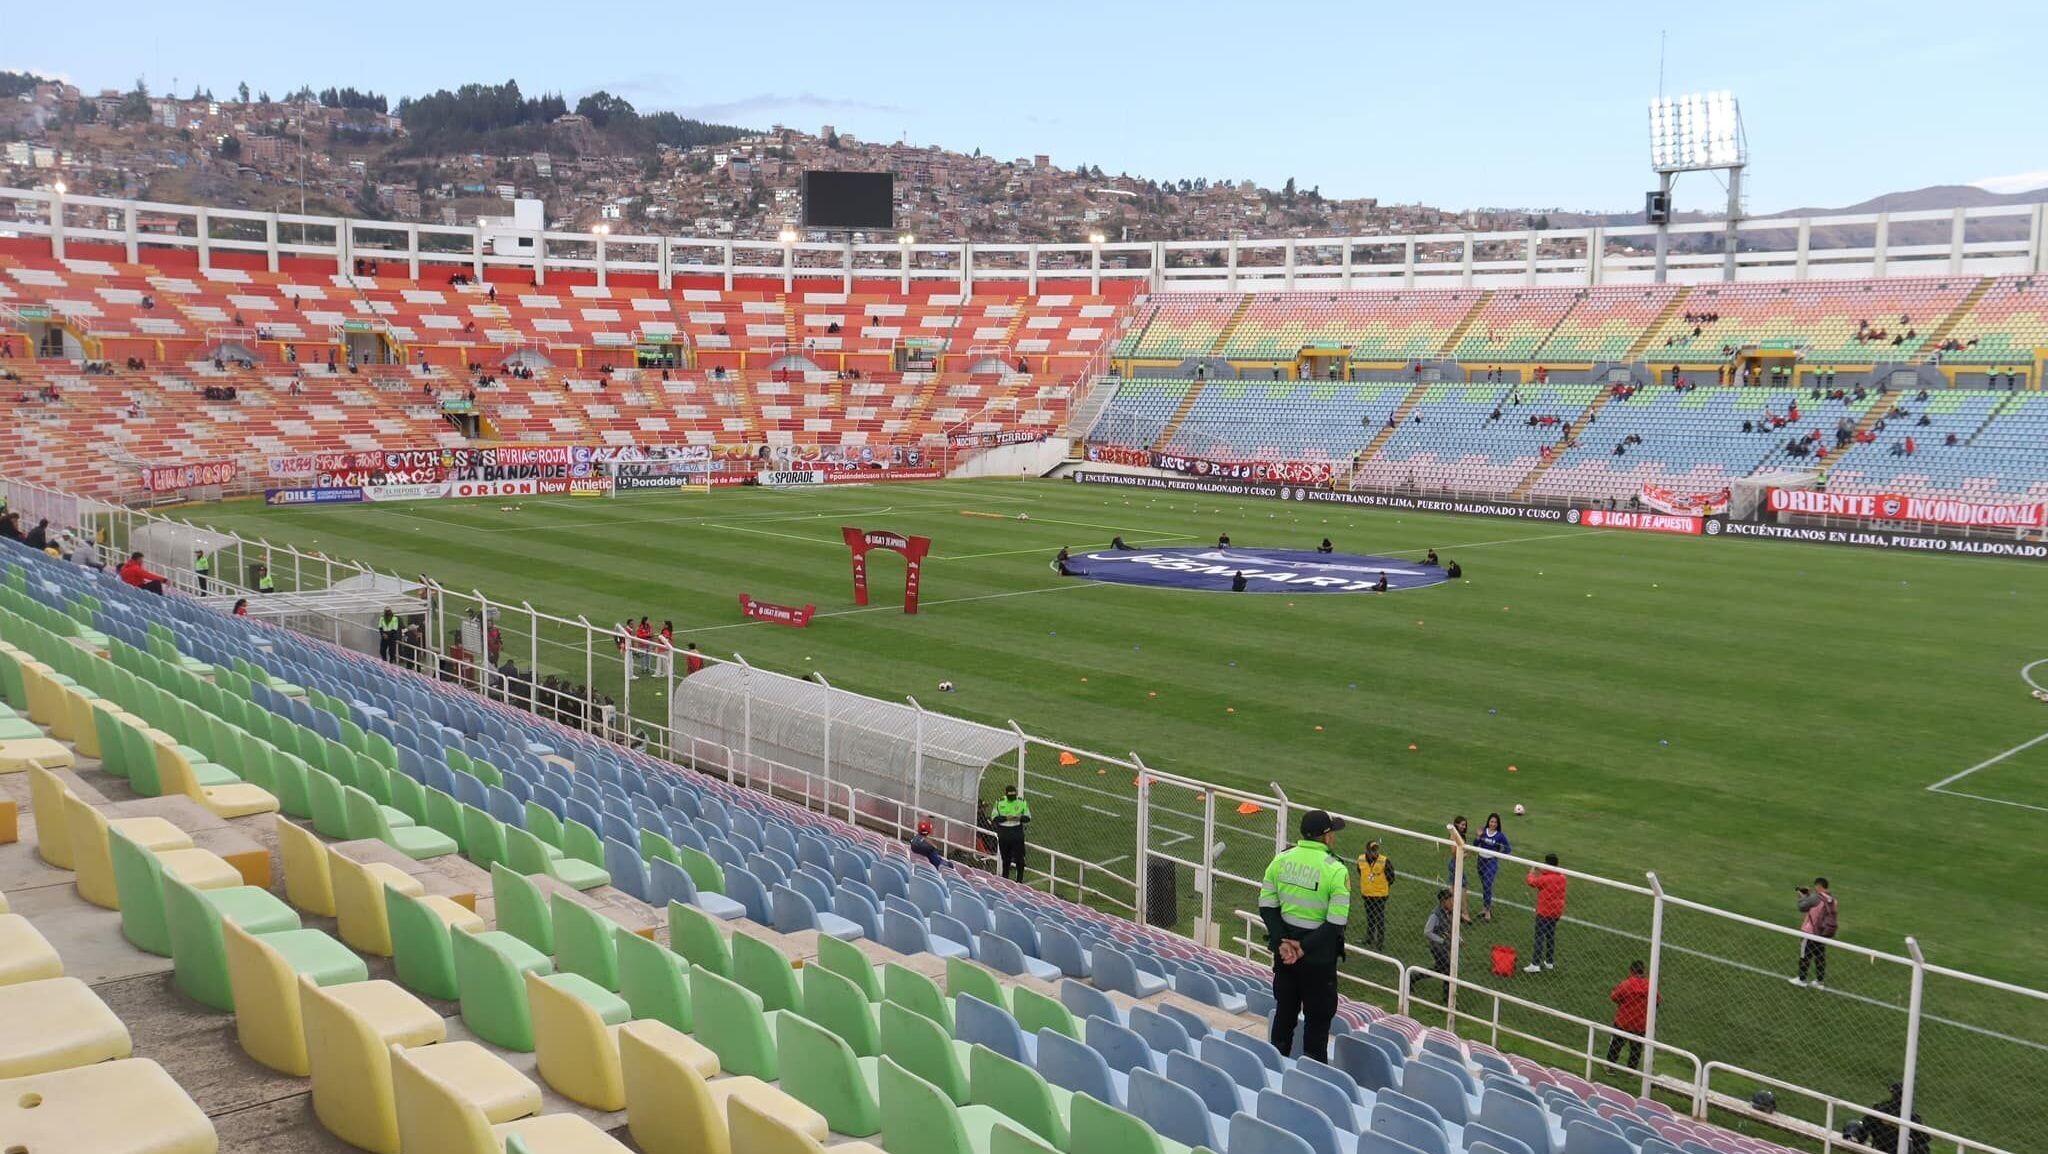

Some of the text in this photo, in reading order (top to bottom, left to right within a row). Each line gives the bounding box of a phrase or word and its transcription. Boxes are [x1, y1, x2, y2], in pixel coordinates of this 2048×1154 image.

[997, 432, 1034, 443] TERROR
[539, 448, 566, 463] ROJA
[458, 467, 478, 480] LA
[484, 465, 540, 480] BANDA
[775, 471, 814, 484] SPORADE
[540, 479, 612, 493] New Athletic
[632, 476, 688, 487] DoradoBet
[1085, 474, 1137, 485] ENCUÉNTRANOS
[1137, 478, 1146, 486] EN
[1147, 479, 1167, 489] LIMA,
[1168, 481, 1195, 491] PUERTO
[1195, 482, 1243, 495] MALDONADO
[1250, 486, 1276, 497] CUSCO
[1309, 491, 1561, 520] ENCUÉNTRANOS EN LIMA, PUERTO MALDONADO Y CUSCO
[1771, 488, 2037, 525] ORIENTE INCONDICIONAL
[1653, 516, 1693, 531] APUESTO
[1726, 523, 2047, 558] ENCUÉNTRANOS EN LIMA, PUERTO MALDONADO
